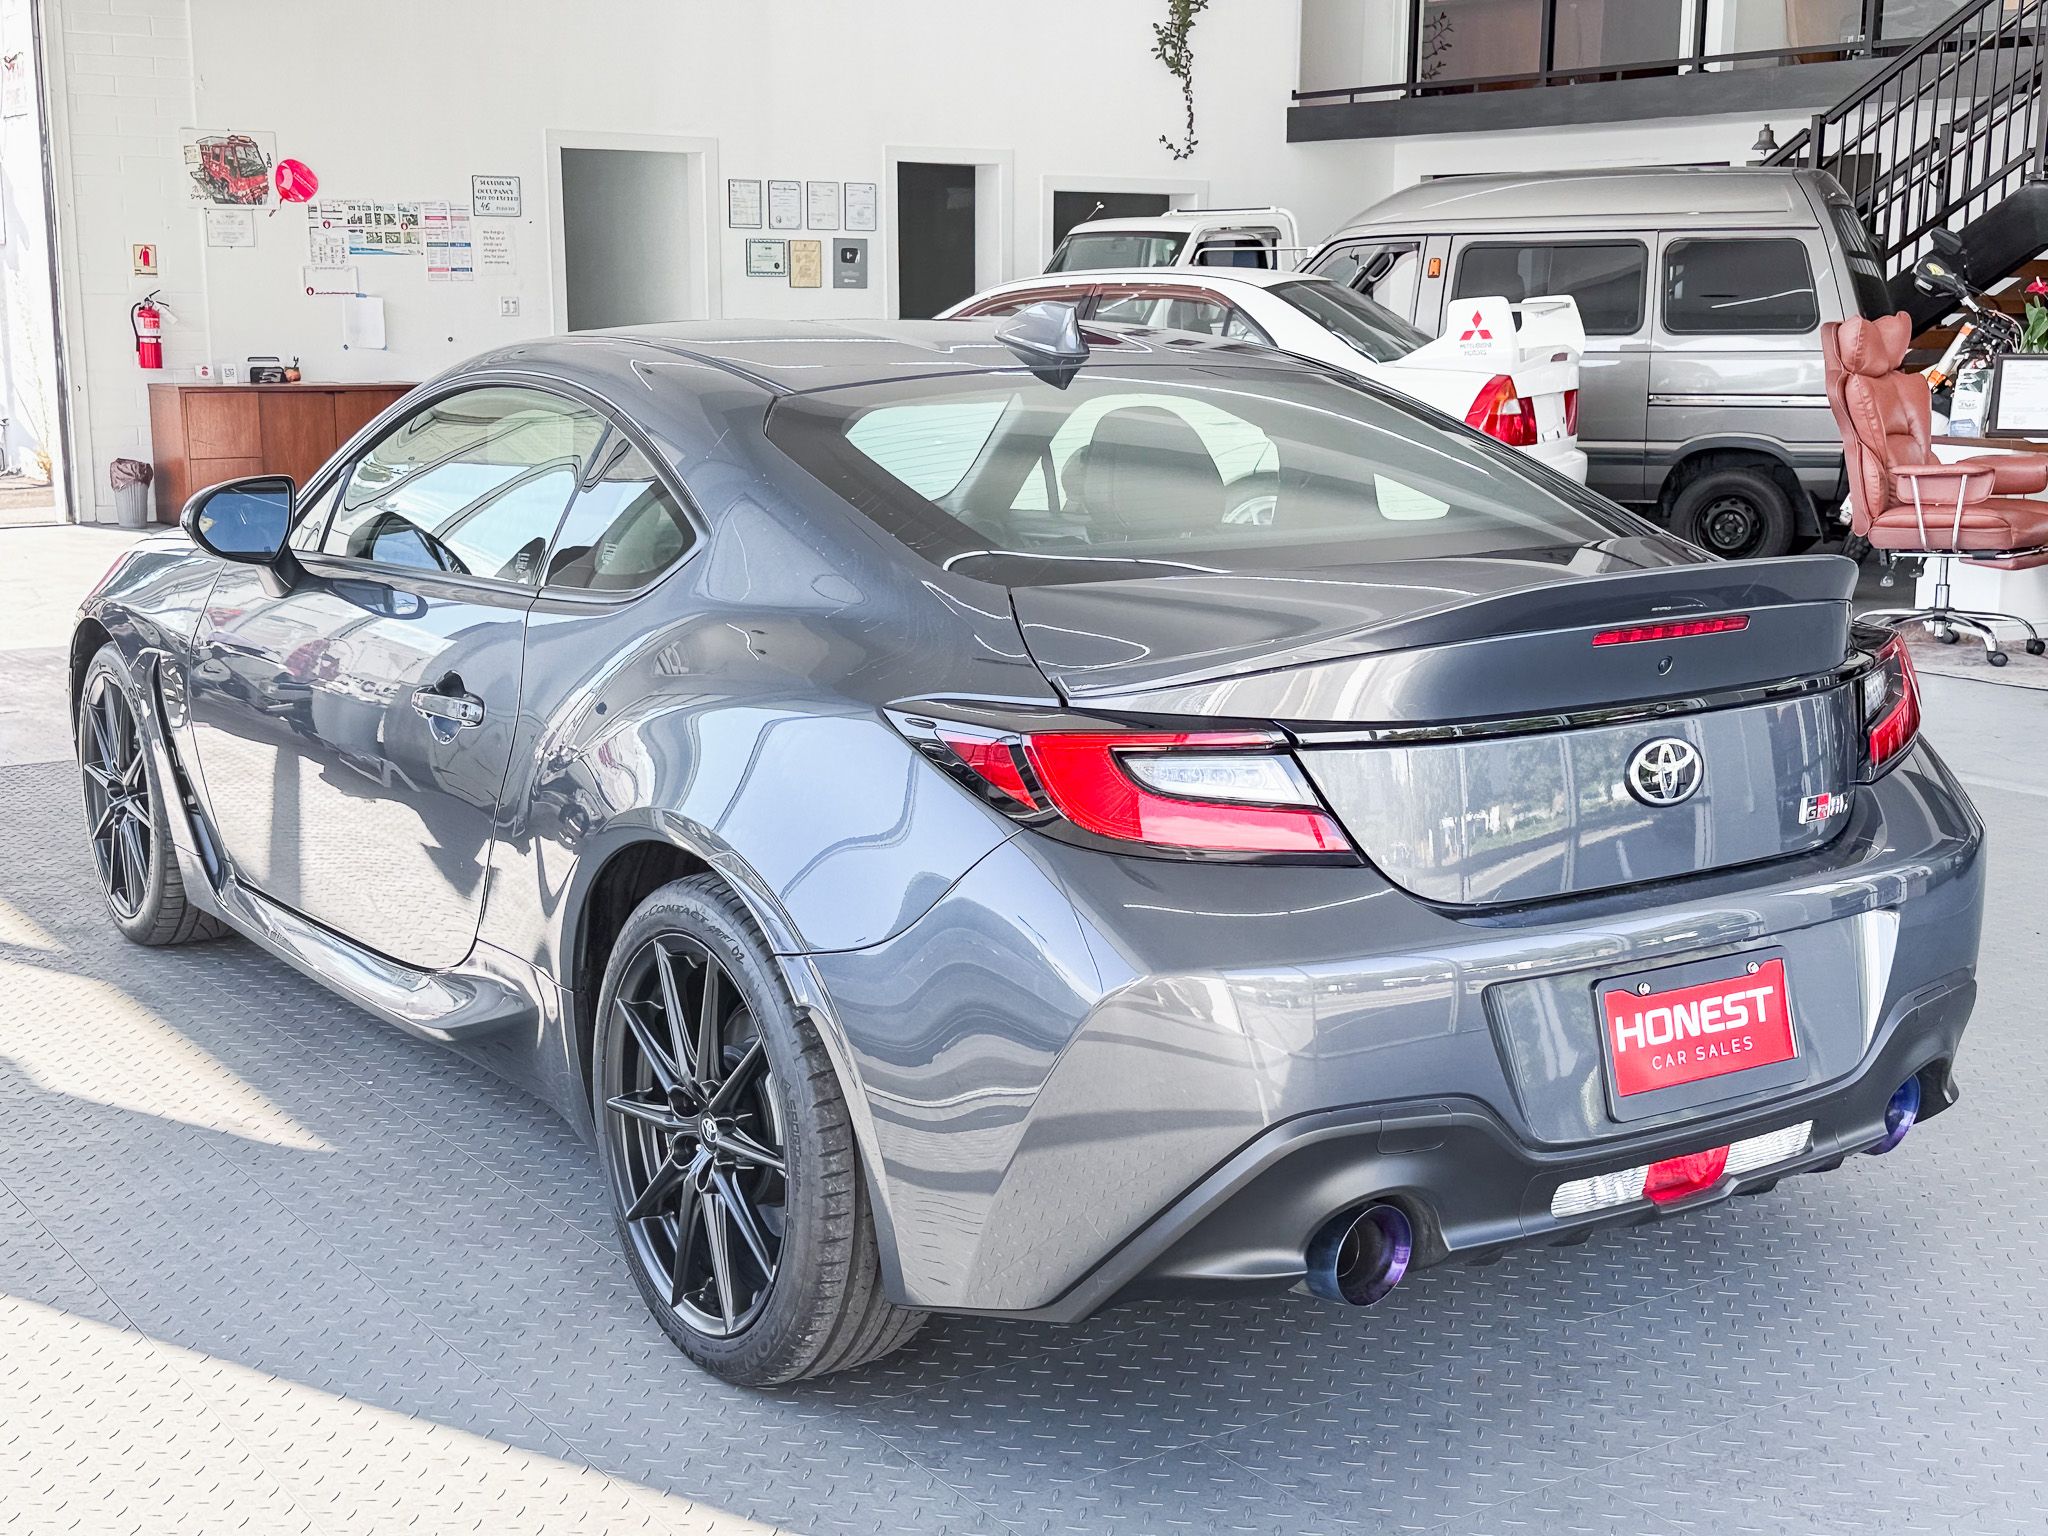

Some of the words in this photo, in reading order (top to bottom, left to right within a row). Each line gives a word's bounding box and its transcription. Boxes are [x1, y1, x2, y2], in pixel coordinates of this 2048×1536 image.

[1615, 985, 1774, 1053] HONEST
[1652, 1050, 1687, 1070] CAR
[1696, 1035, 1754, 1061] SALES
